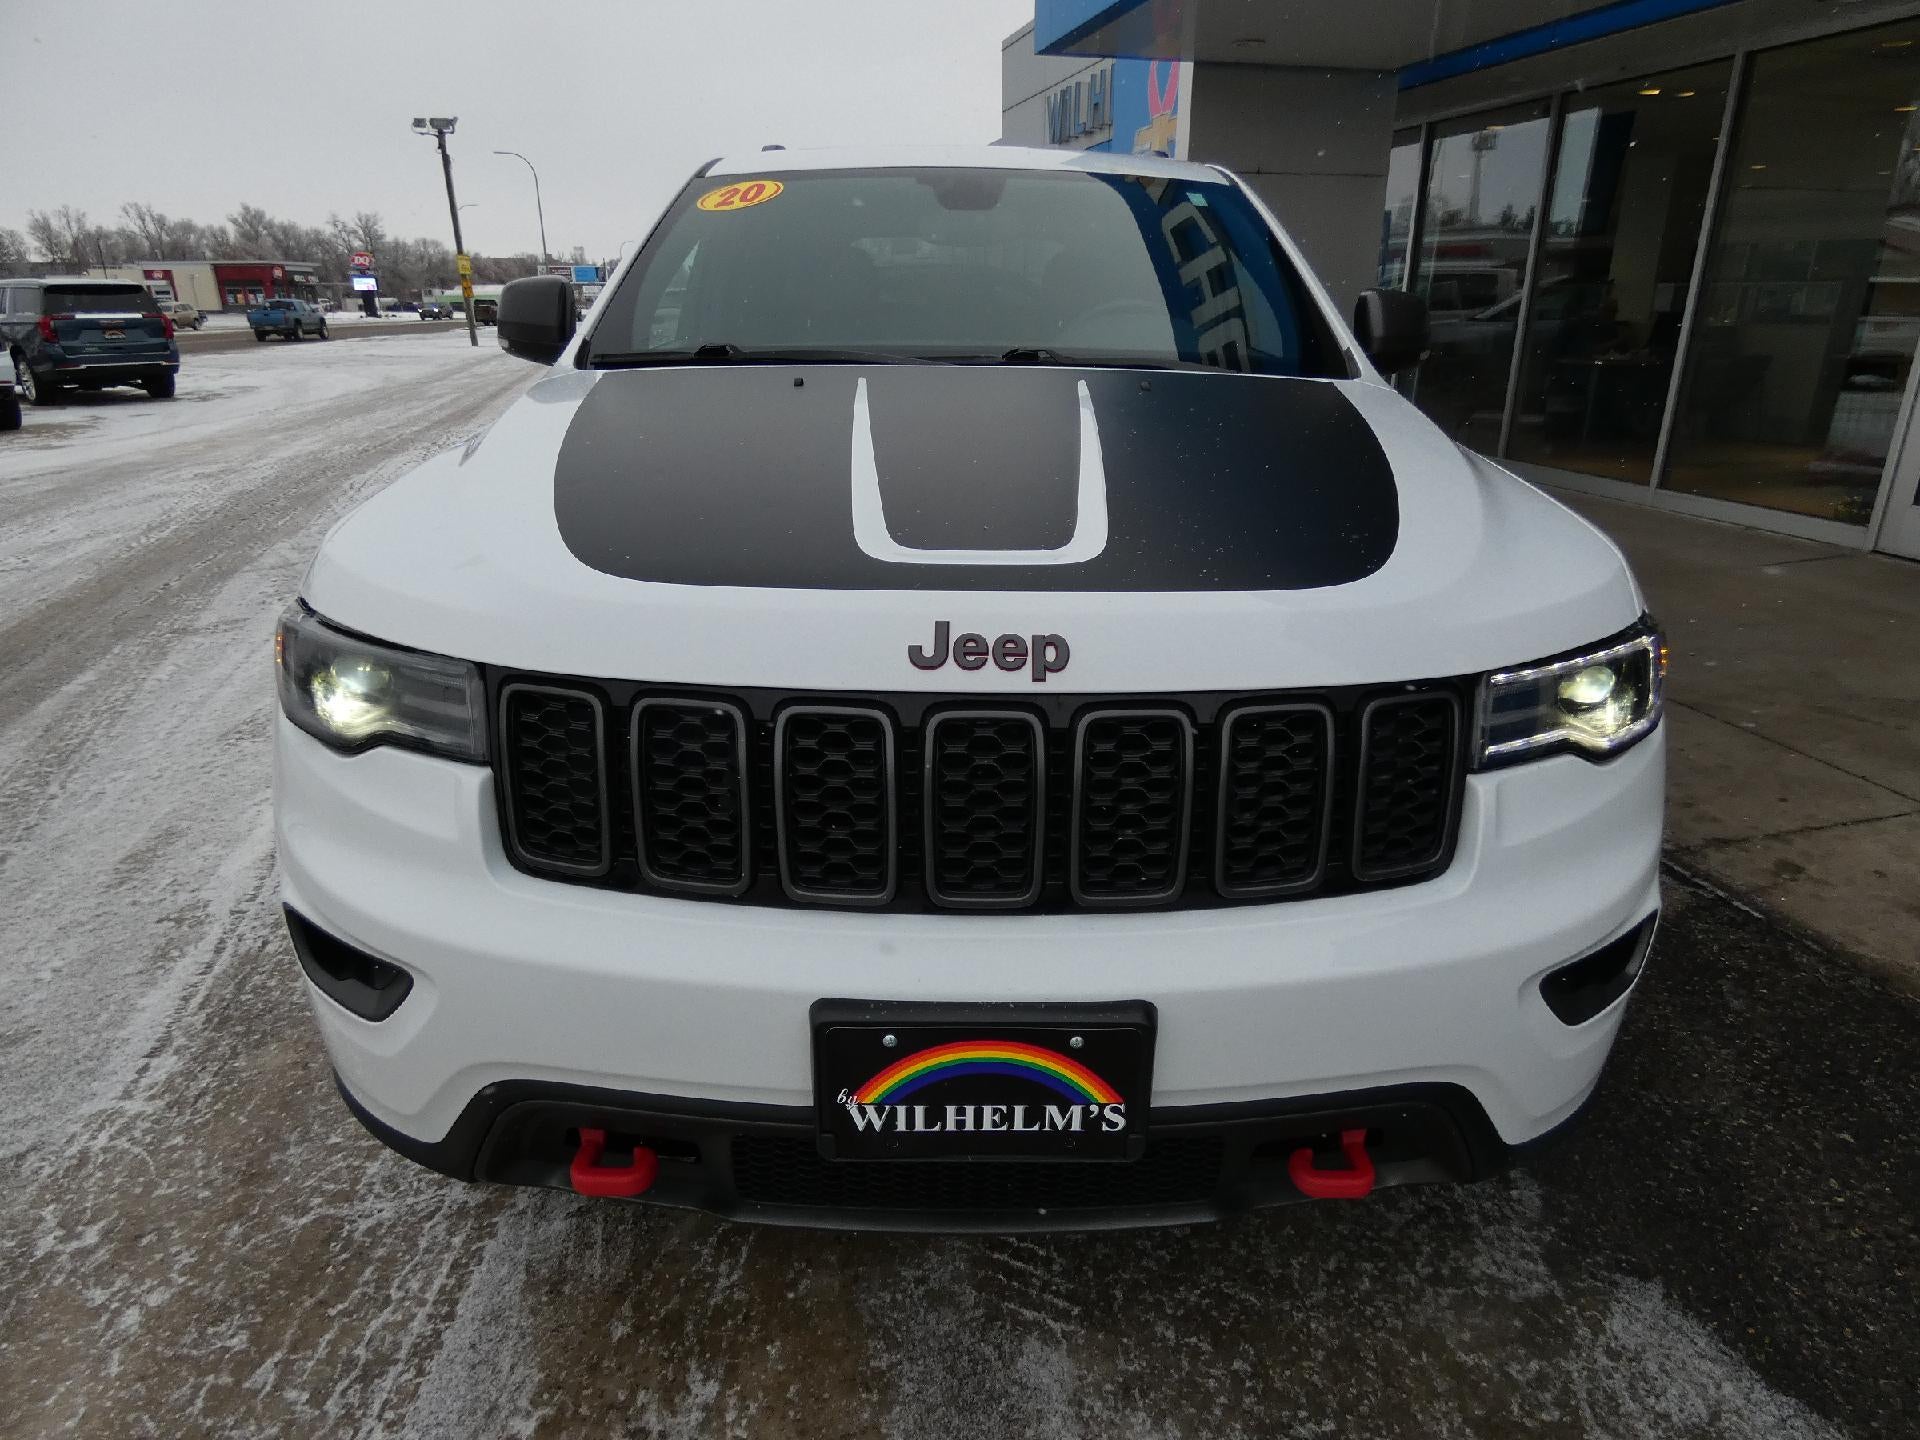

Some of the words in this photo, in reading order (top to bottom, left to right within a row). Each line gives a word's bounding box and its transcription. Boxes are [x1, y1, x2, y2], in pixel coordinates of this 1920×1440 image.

[714, 183, 766, 208] 20
[907, 620, 1071, 682] Jeep
[837, 1088, 859, 1110] by
[848, 1103, 1127, 1132] WILHELM'S
